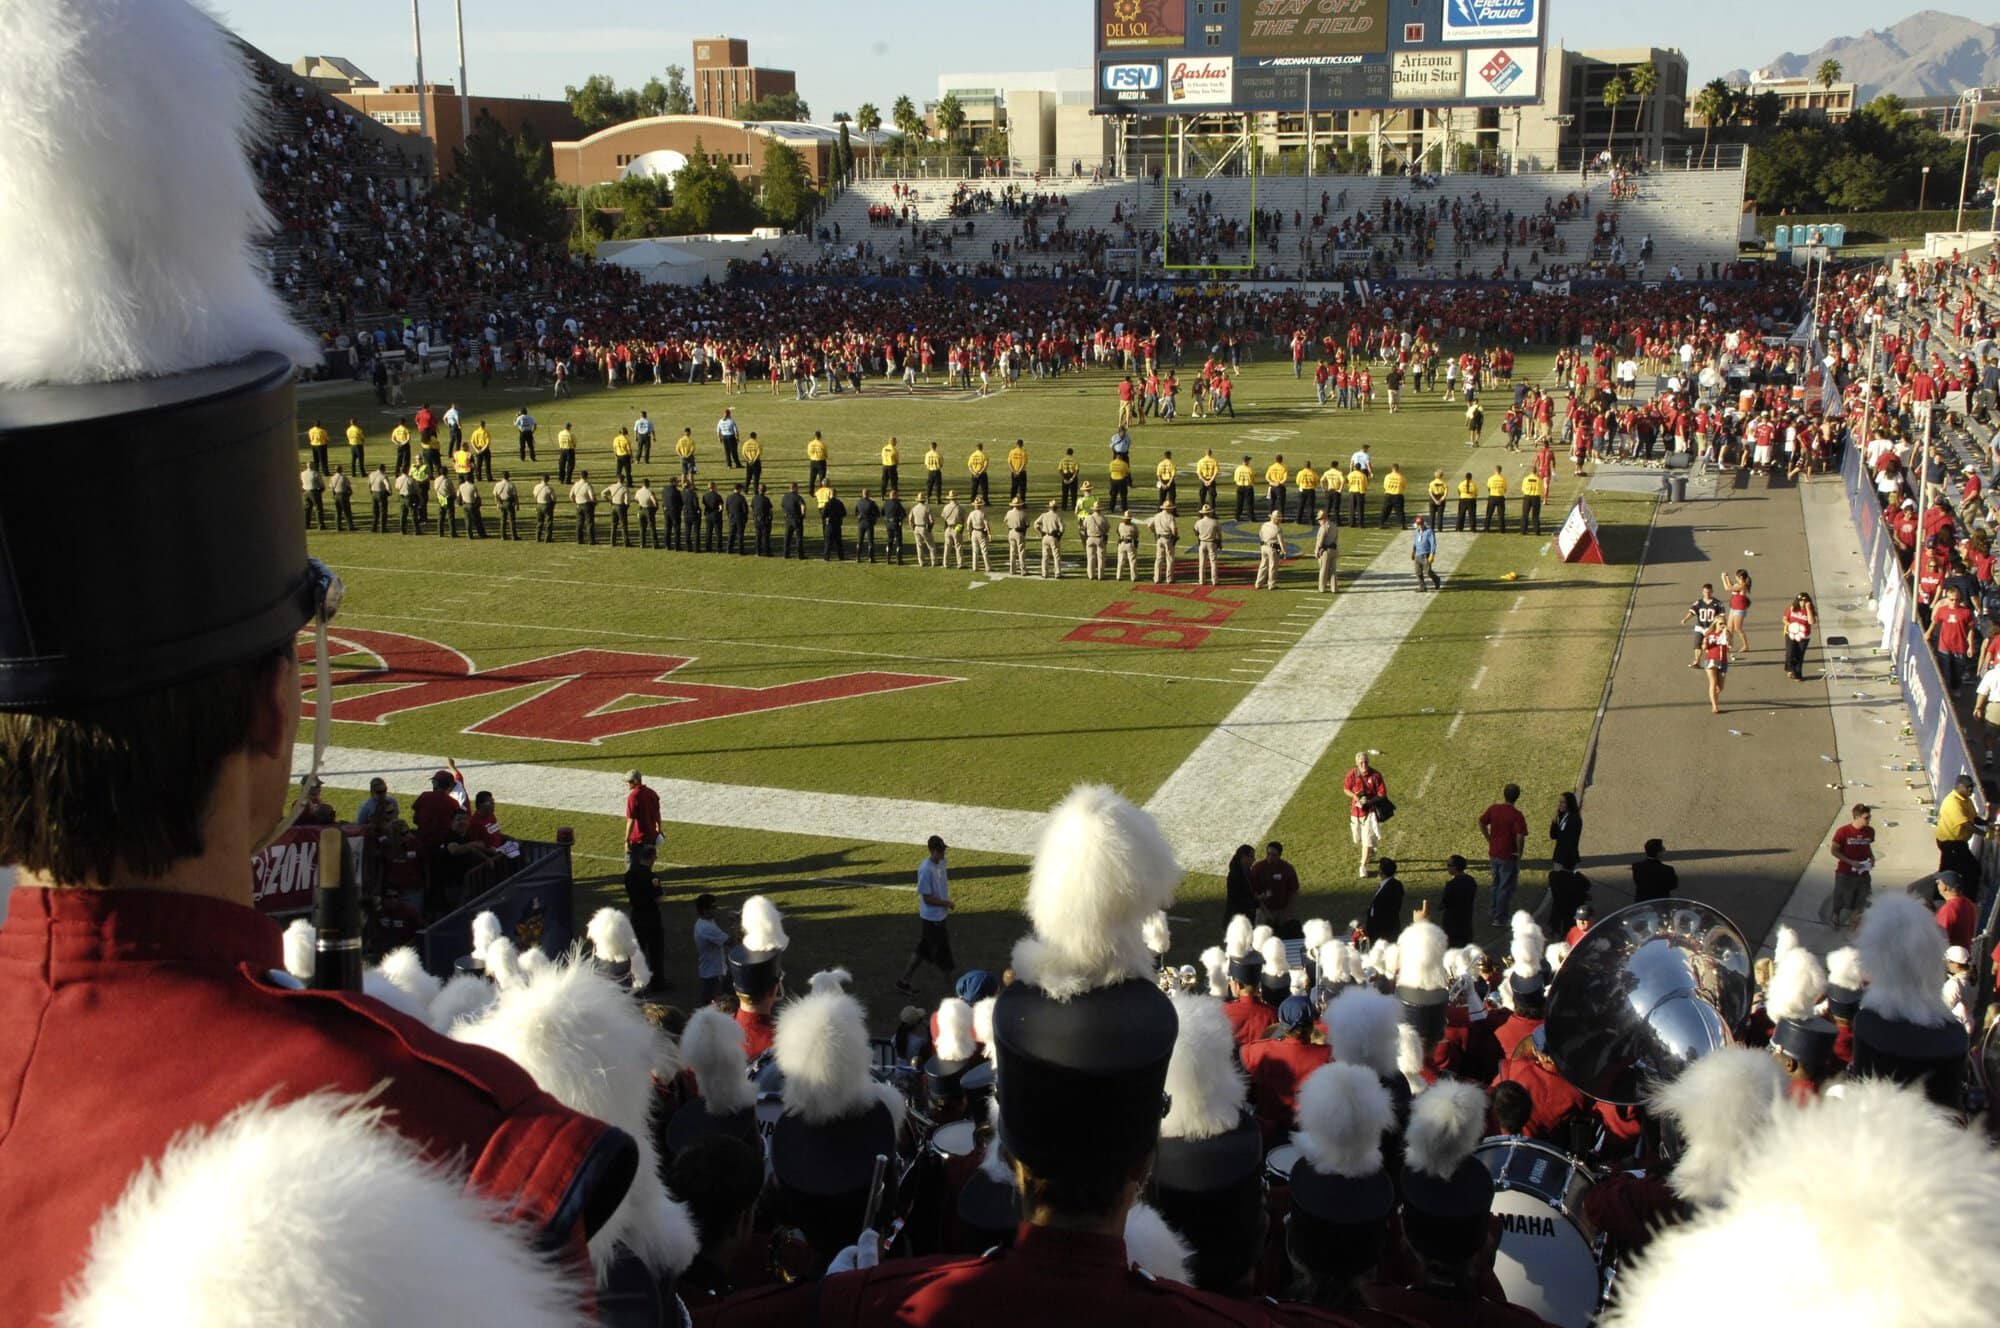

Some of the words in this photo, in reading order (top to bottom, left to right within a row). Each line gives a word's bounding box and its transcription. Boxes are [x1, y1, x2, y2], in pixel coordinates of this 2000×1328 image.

[1255, 0, 1311, 15] STAY
[1478, 7, 1526, 20] Power
[1106, 23, 1126, 37] DEL
[1129, 22, 1150, 36] SOL
[1251, 19, 1299, 37] THE
[1303, 16, 1374, 35] FIELD
[1272, 55, 1363, 66] ARIZONAATHLETICS.COM
[1400, 54, 1453, 68] Arizona
[1112, 67, 1153, 87] FSN
[1391, 70, 1428, 85] Daily
[1430, 68, 1461, 83] Star
[1699, 608, 1715, 622] 00
